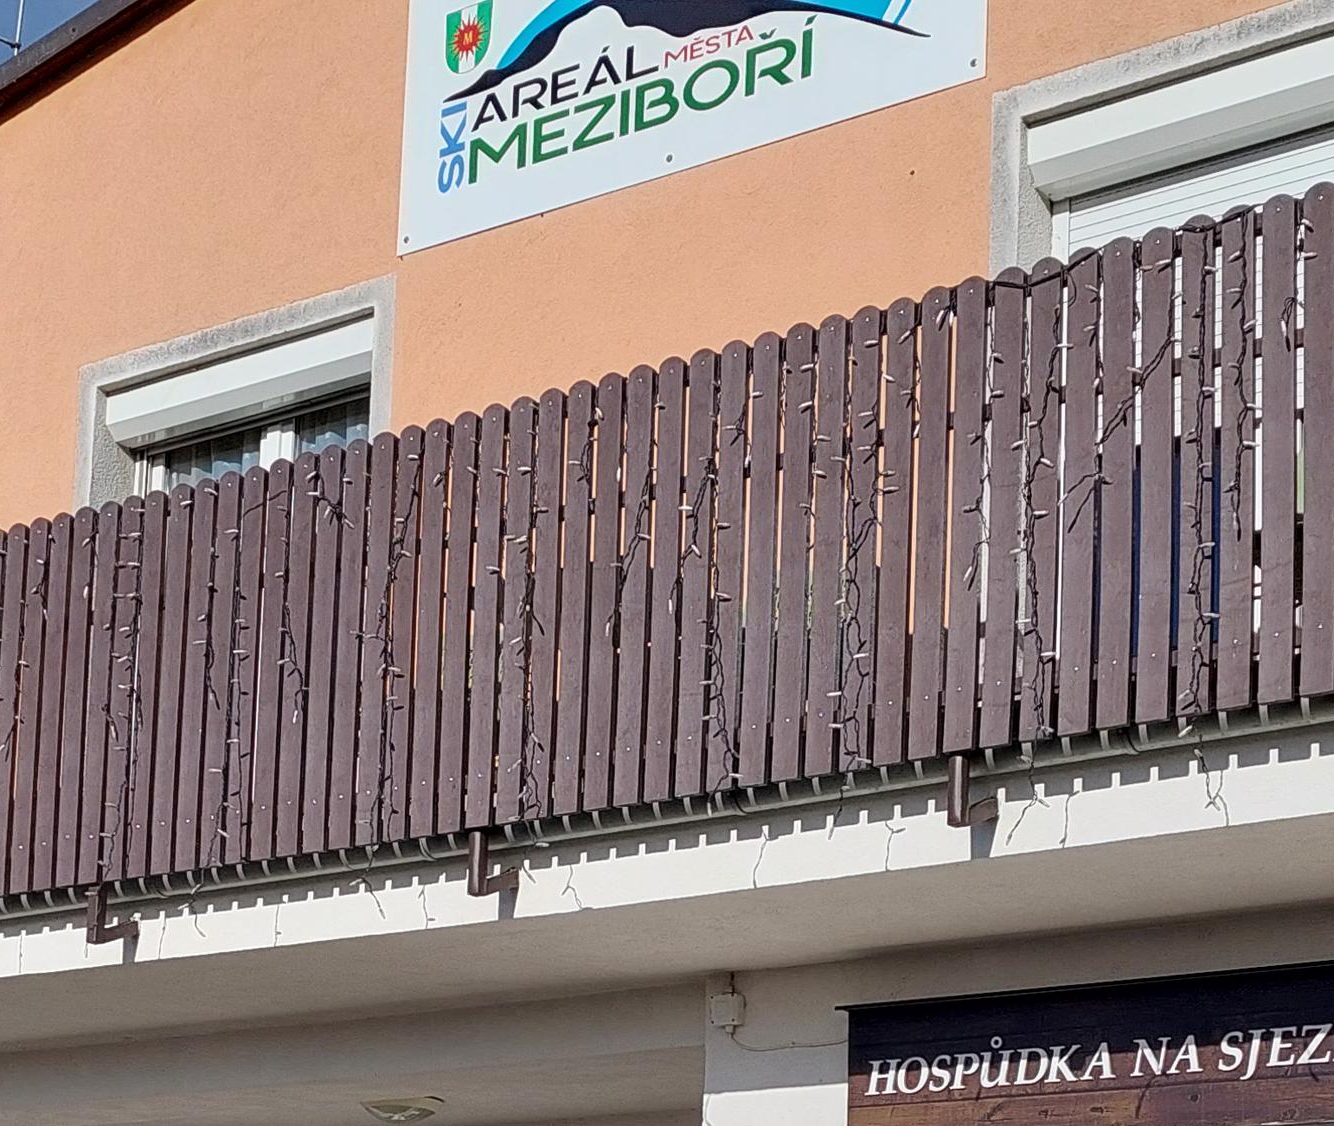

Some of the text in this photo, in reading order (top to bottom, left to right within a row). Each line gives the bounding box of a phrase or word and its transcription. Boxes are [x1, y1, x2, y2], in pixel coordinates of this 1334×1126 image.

[468, 14, 818, 185] MEZIBOŘÍ
[471, 25, 754, 132] AREÁL MĚSTA
[438, 101, 467, 194] SKI
[864, 1036, 1116, 1096] HOSPŮDKA
[1130, 1034, 1204, 1078] NA
